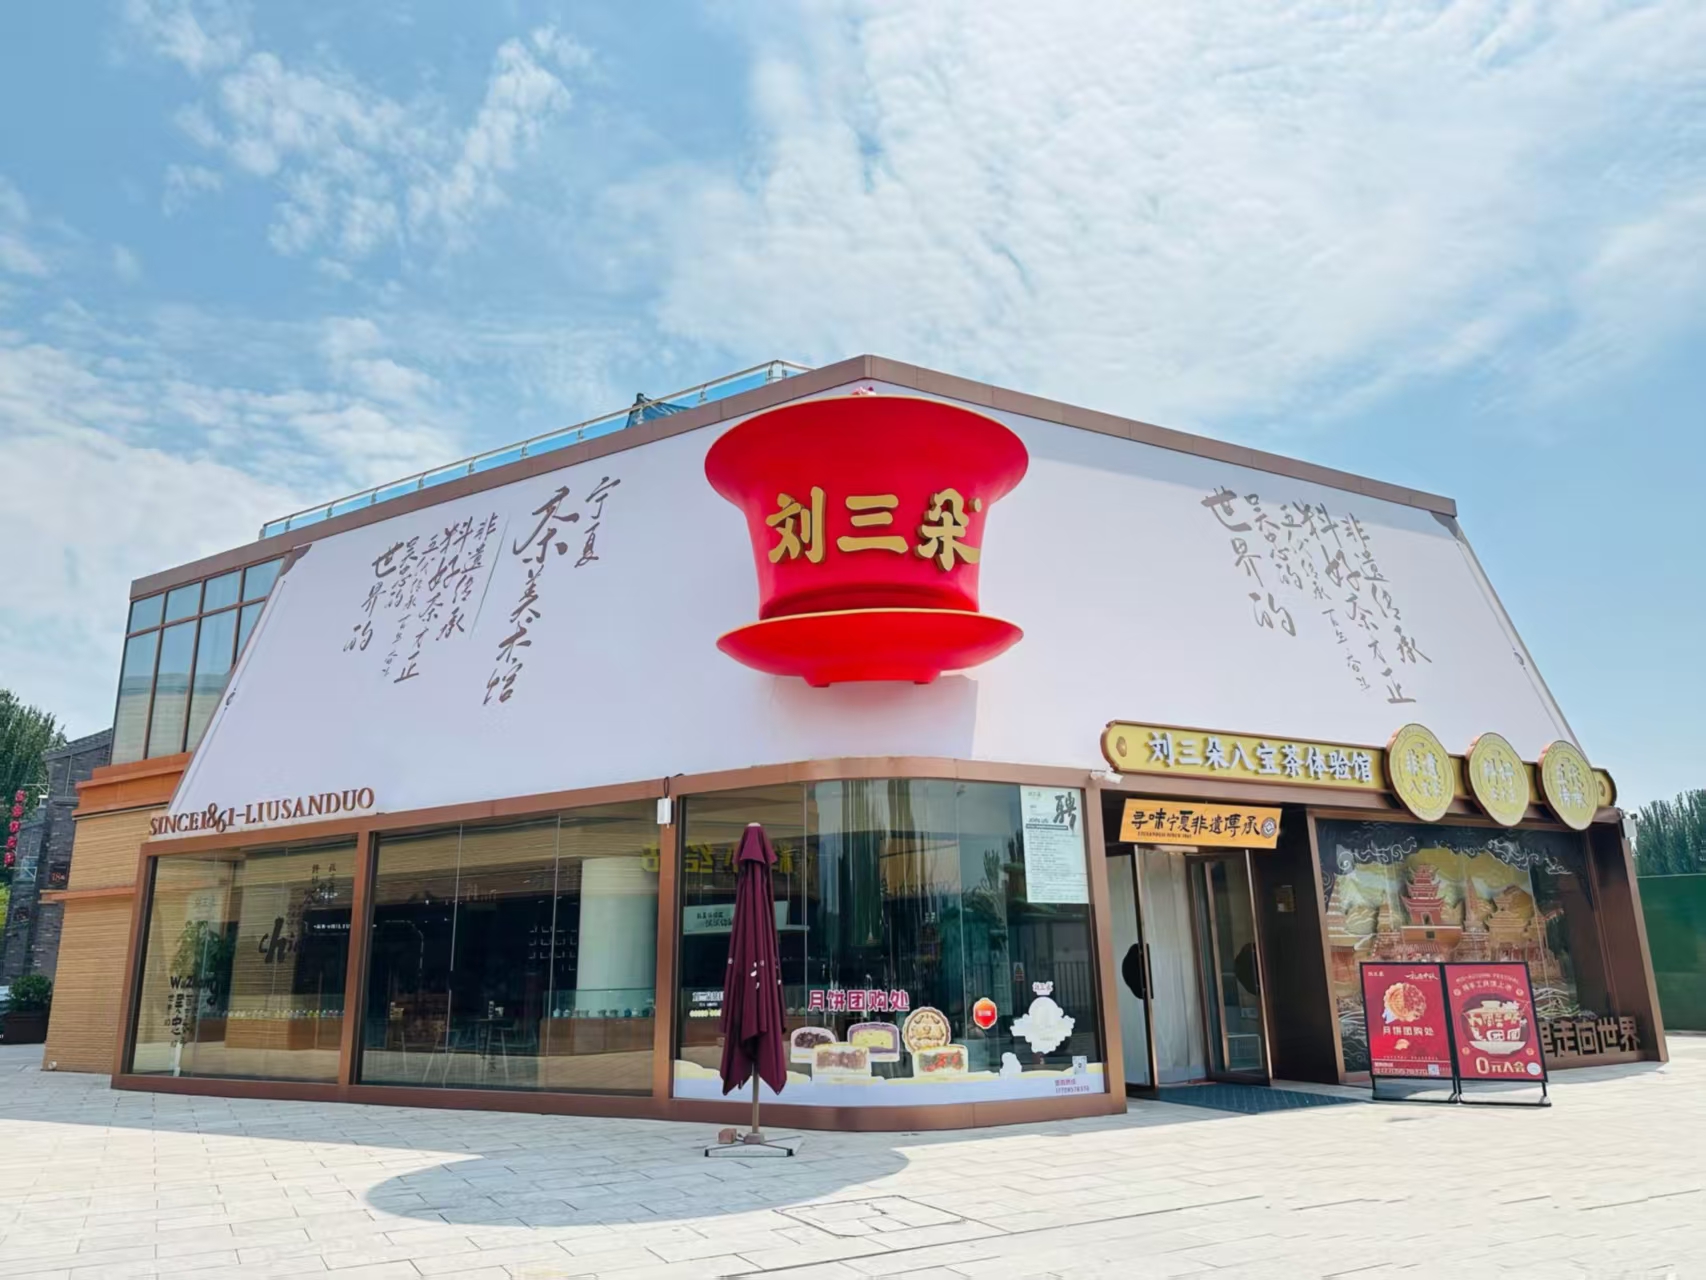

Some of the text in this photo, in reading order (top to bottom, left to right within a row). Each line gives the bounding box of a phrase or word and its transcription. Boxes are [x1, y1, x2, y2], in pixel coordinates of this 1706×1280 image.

[574, 476, 621, 568] 宁夏
[765, 486, 981, 571] 刘三朵
[343, 541, 404, 652] 世界的
[1147, 732, 1373, 783] 刘三朵八宝茶体验馆
[1053, 791, 1077, 836] 聘
[808, 989, 910, 1012] 月饼团购处
[1383, 1025, 1434, 1036] 月饼团购处
